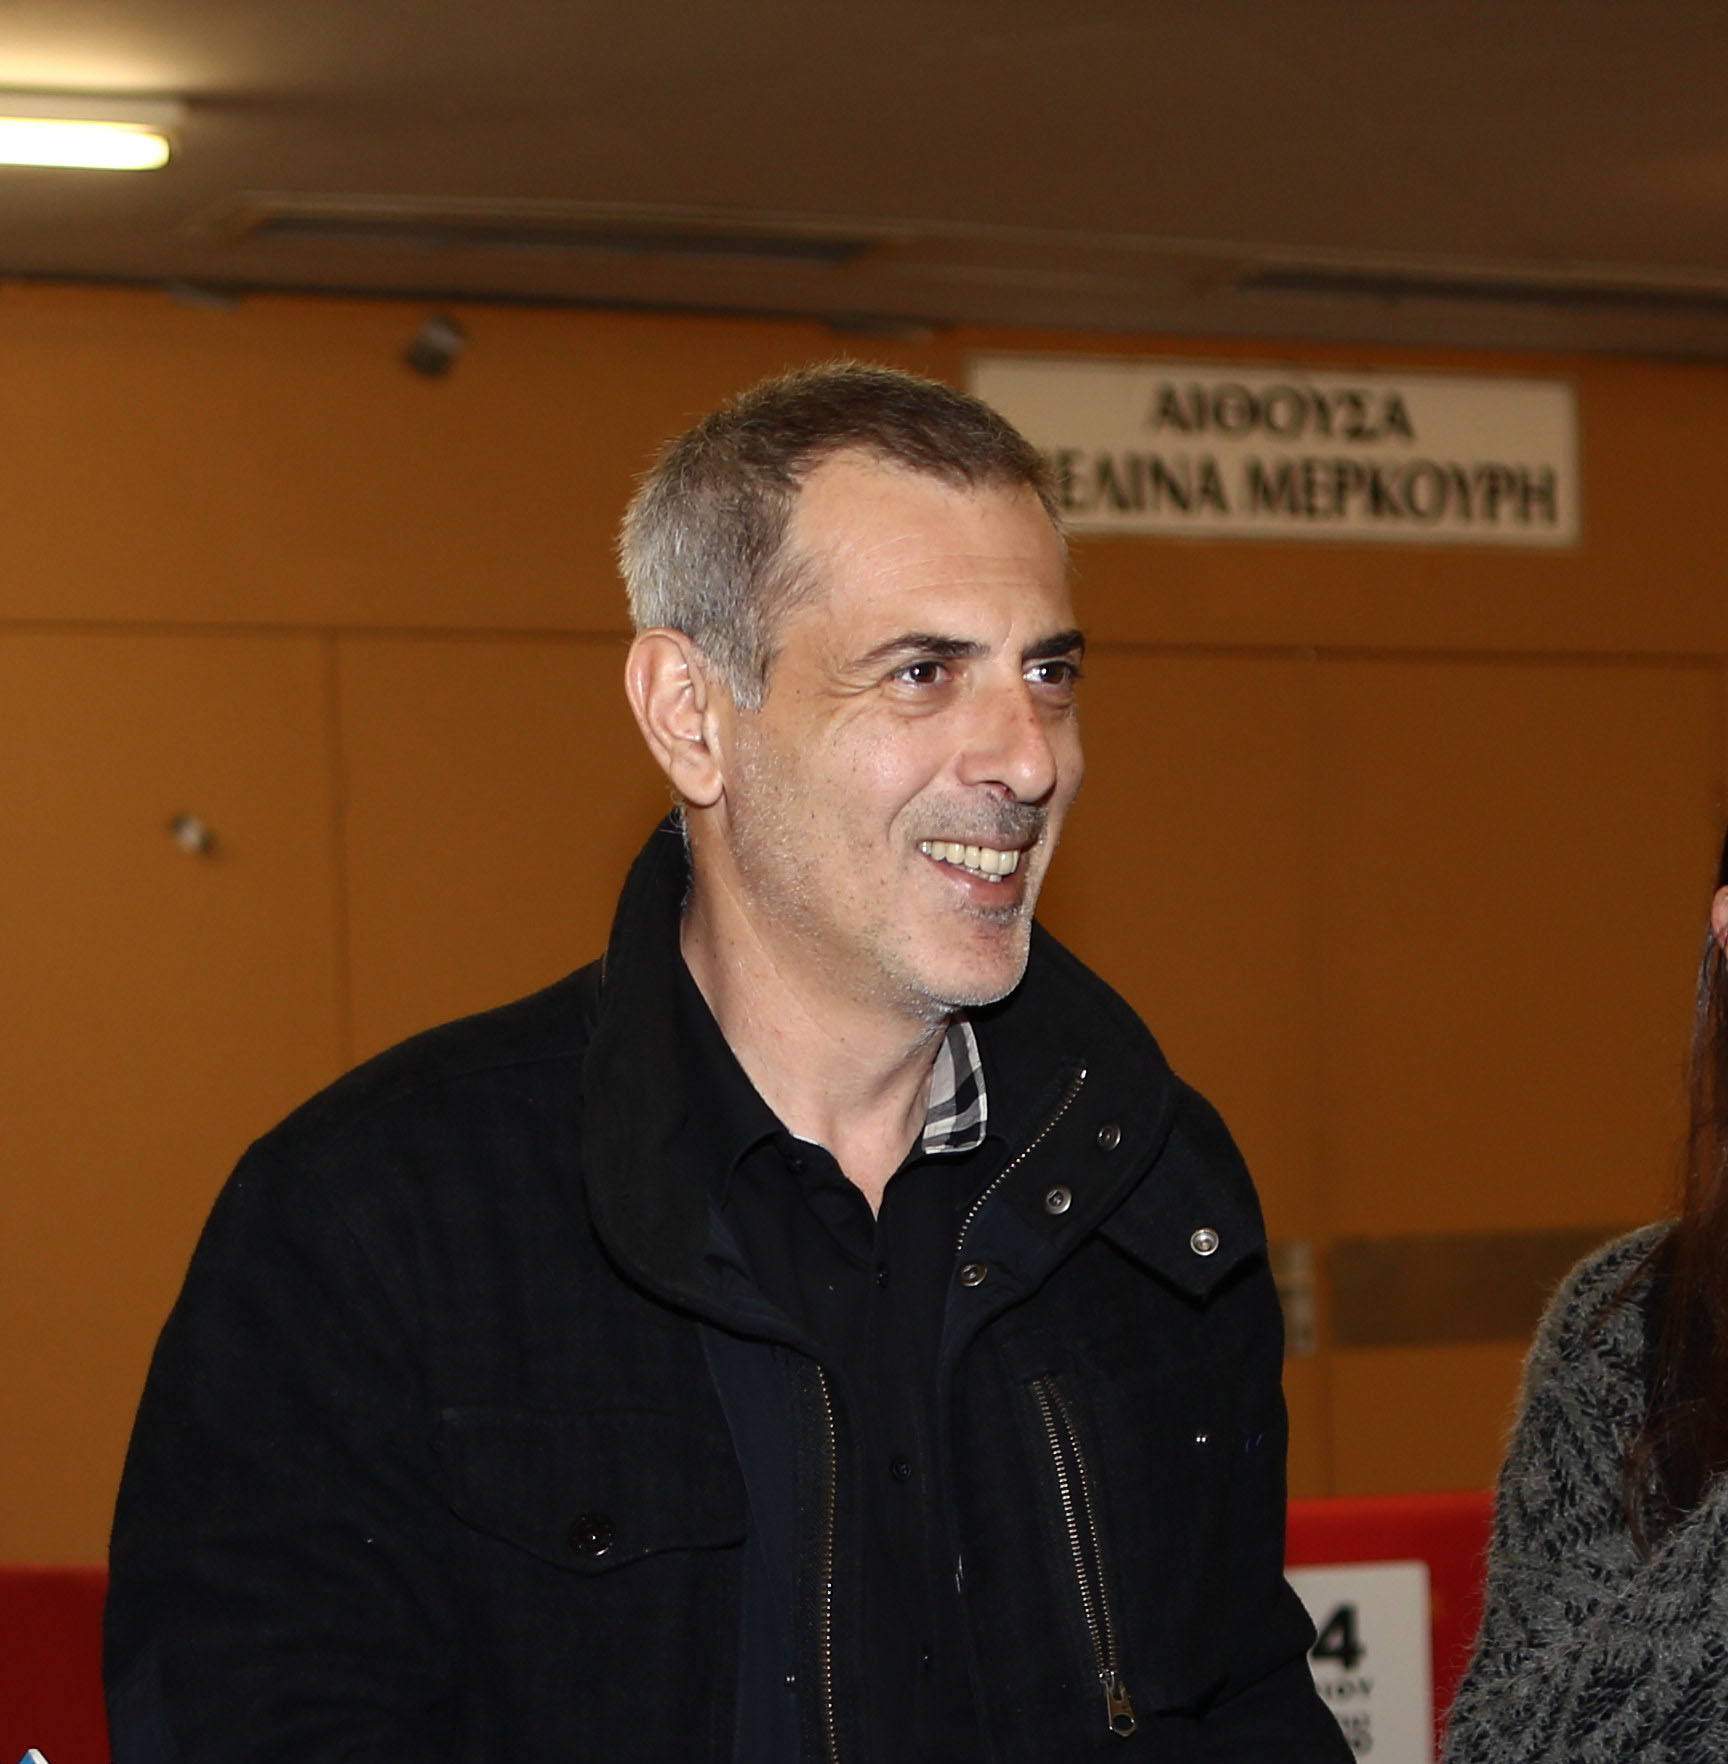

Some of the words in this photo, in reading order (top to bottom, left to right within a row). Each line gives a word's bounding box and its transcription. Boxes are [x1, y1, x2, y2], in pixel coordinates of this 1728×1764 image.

[1151, 380, 1415, 443] ΑΙΘΟΥΣΑ
[1054, 448, 1234, 515] ΕΛΙΝΑ
[1244, 454, 1559, 527] ΜΕΡΚΟΥΡΗ
